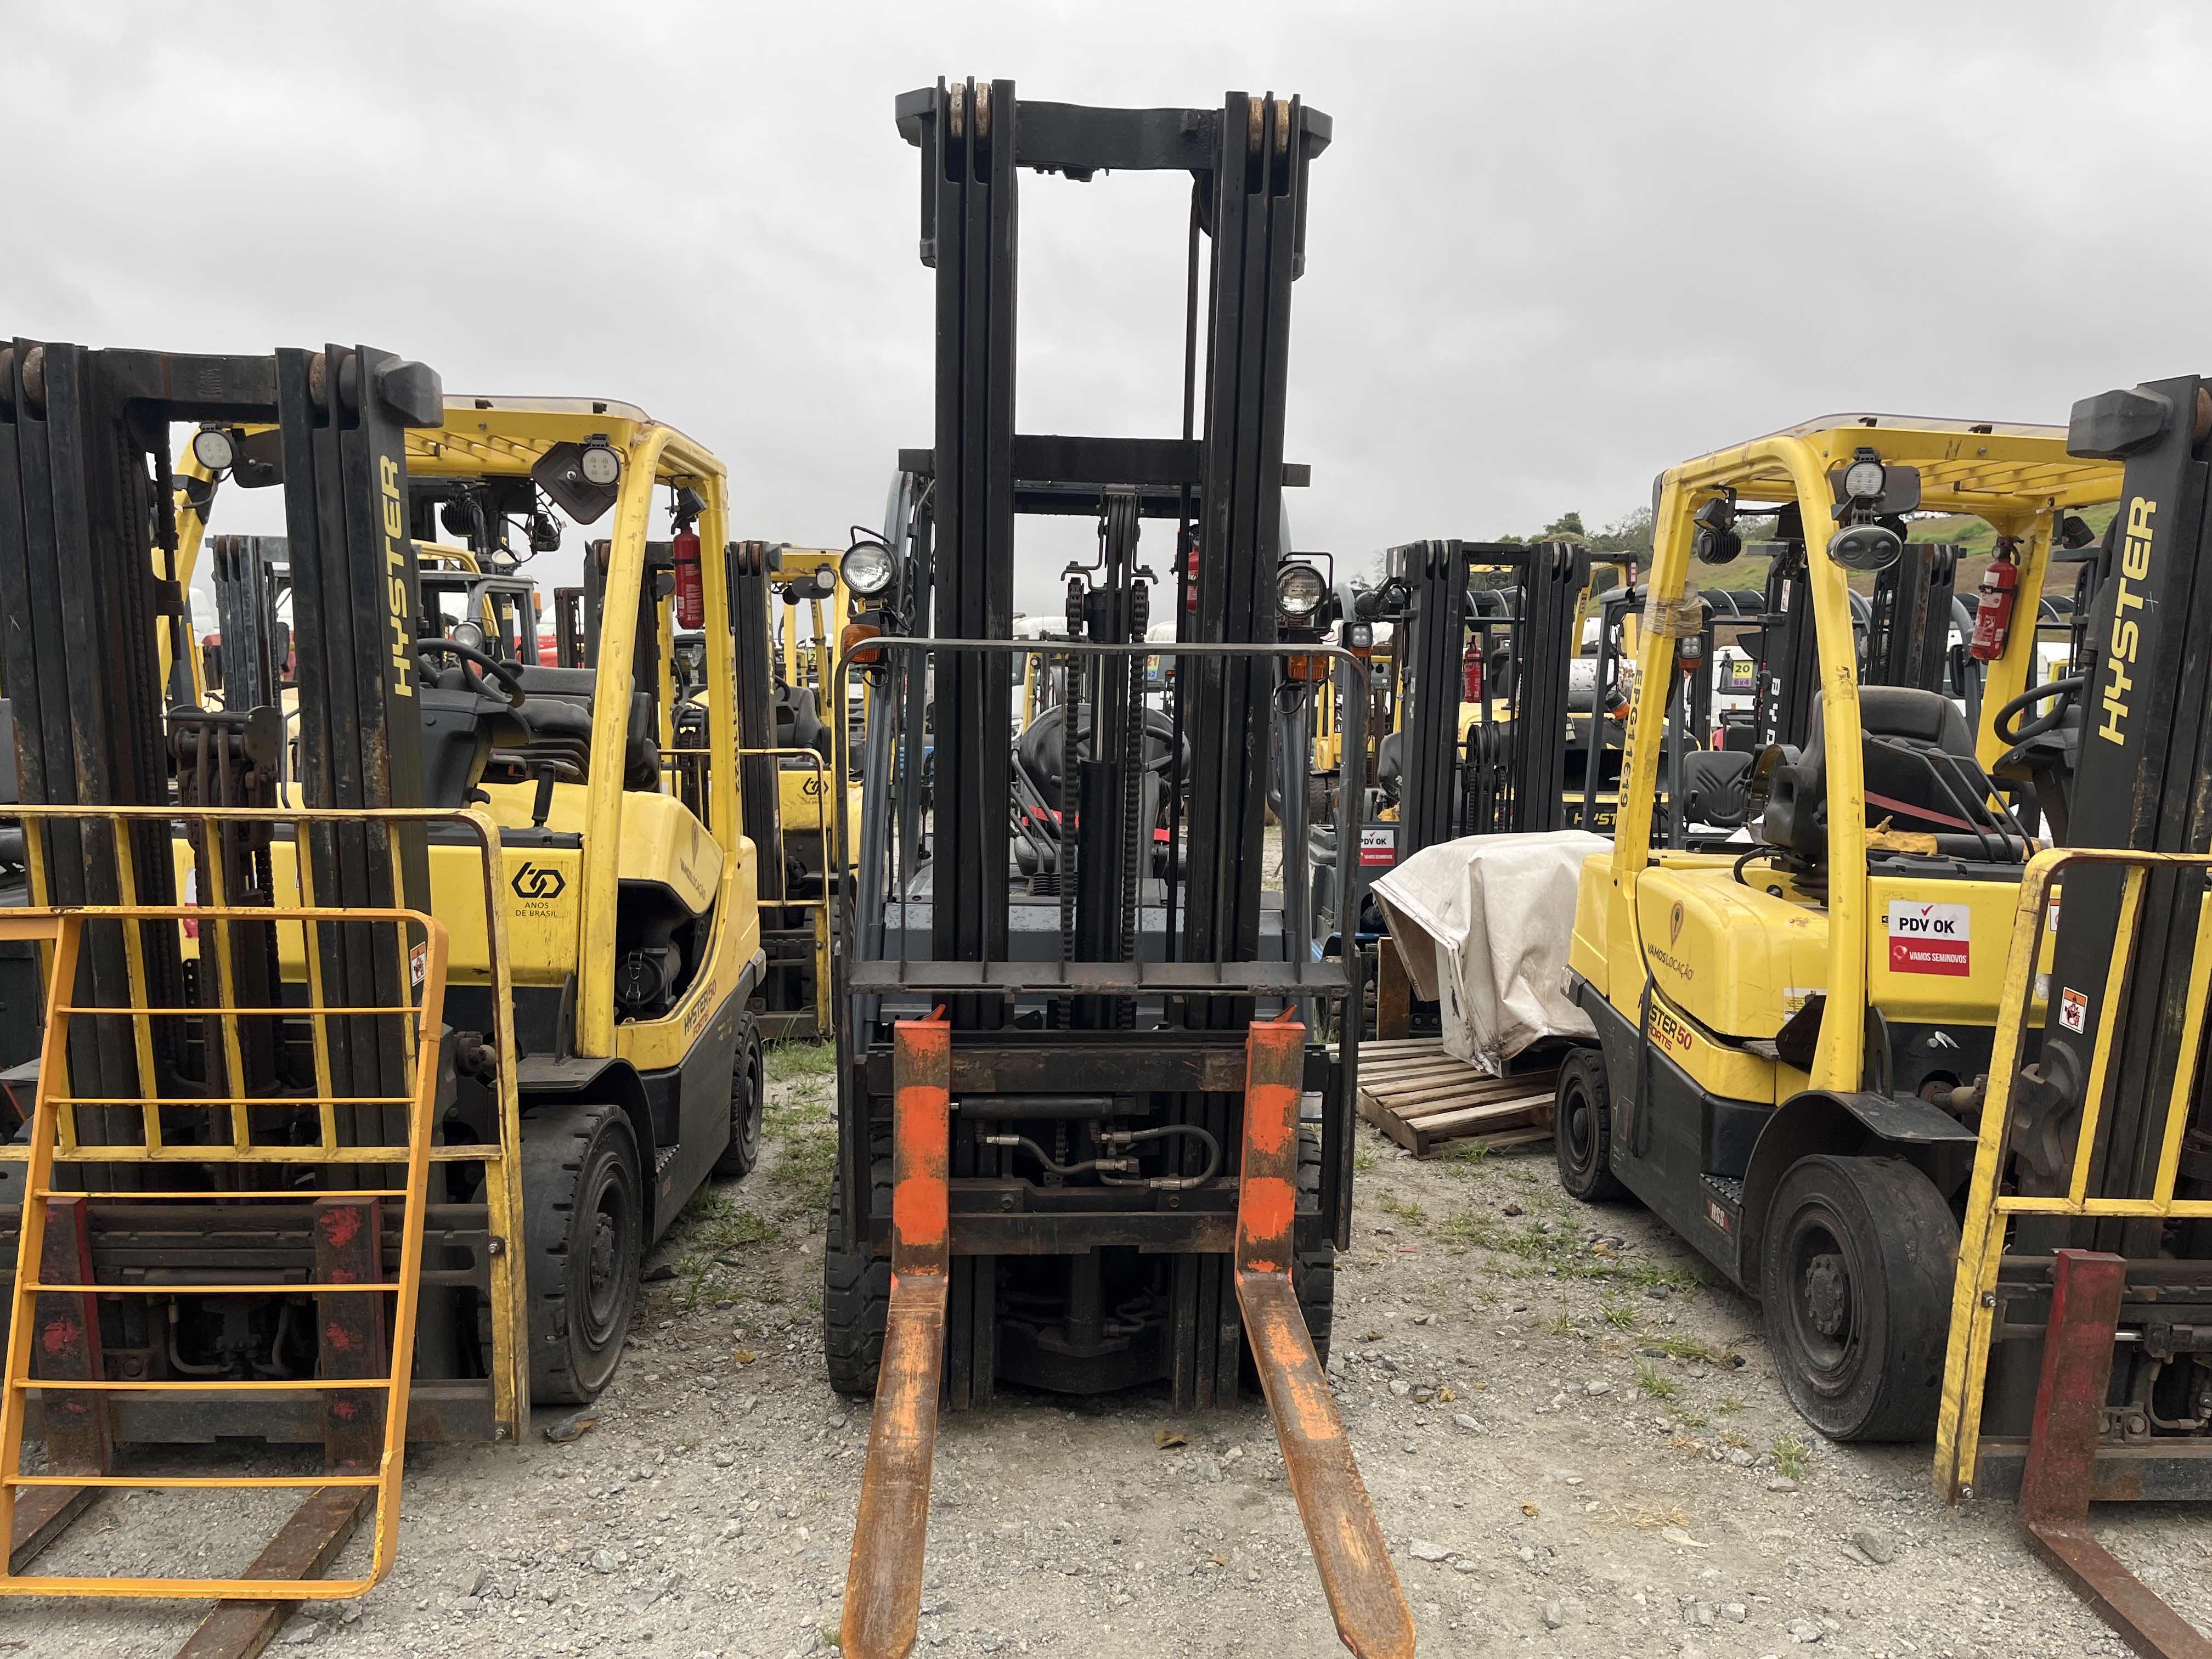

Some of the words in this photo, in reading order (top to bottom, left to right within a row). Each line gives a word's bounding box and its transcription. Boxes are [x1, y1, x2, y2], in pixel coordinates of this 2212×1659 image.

[381, 454, 413, 697] HYSTER
[2098, 496, 2157, 746] HYSTER
[1573, 812, 1617, 825] HST
[1899, 917, 1929, 932] PDV
[1934, 919, 1955, 934] OK
[1909, 951, 1931, 962] VAMOS
[1932, 953, 1967, 964] SEMINOVOS
[684, 989, 708, 1036] HYSTER
[708, 978, 716, 1002] 50
[1638, 992, 1678, 1039] STER
[1677, 1026, 1692, 1051] 50
